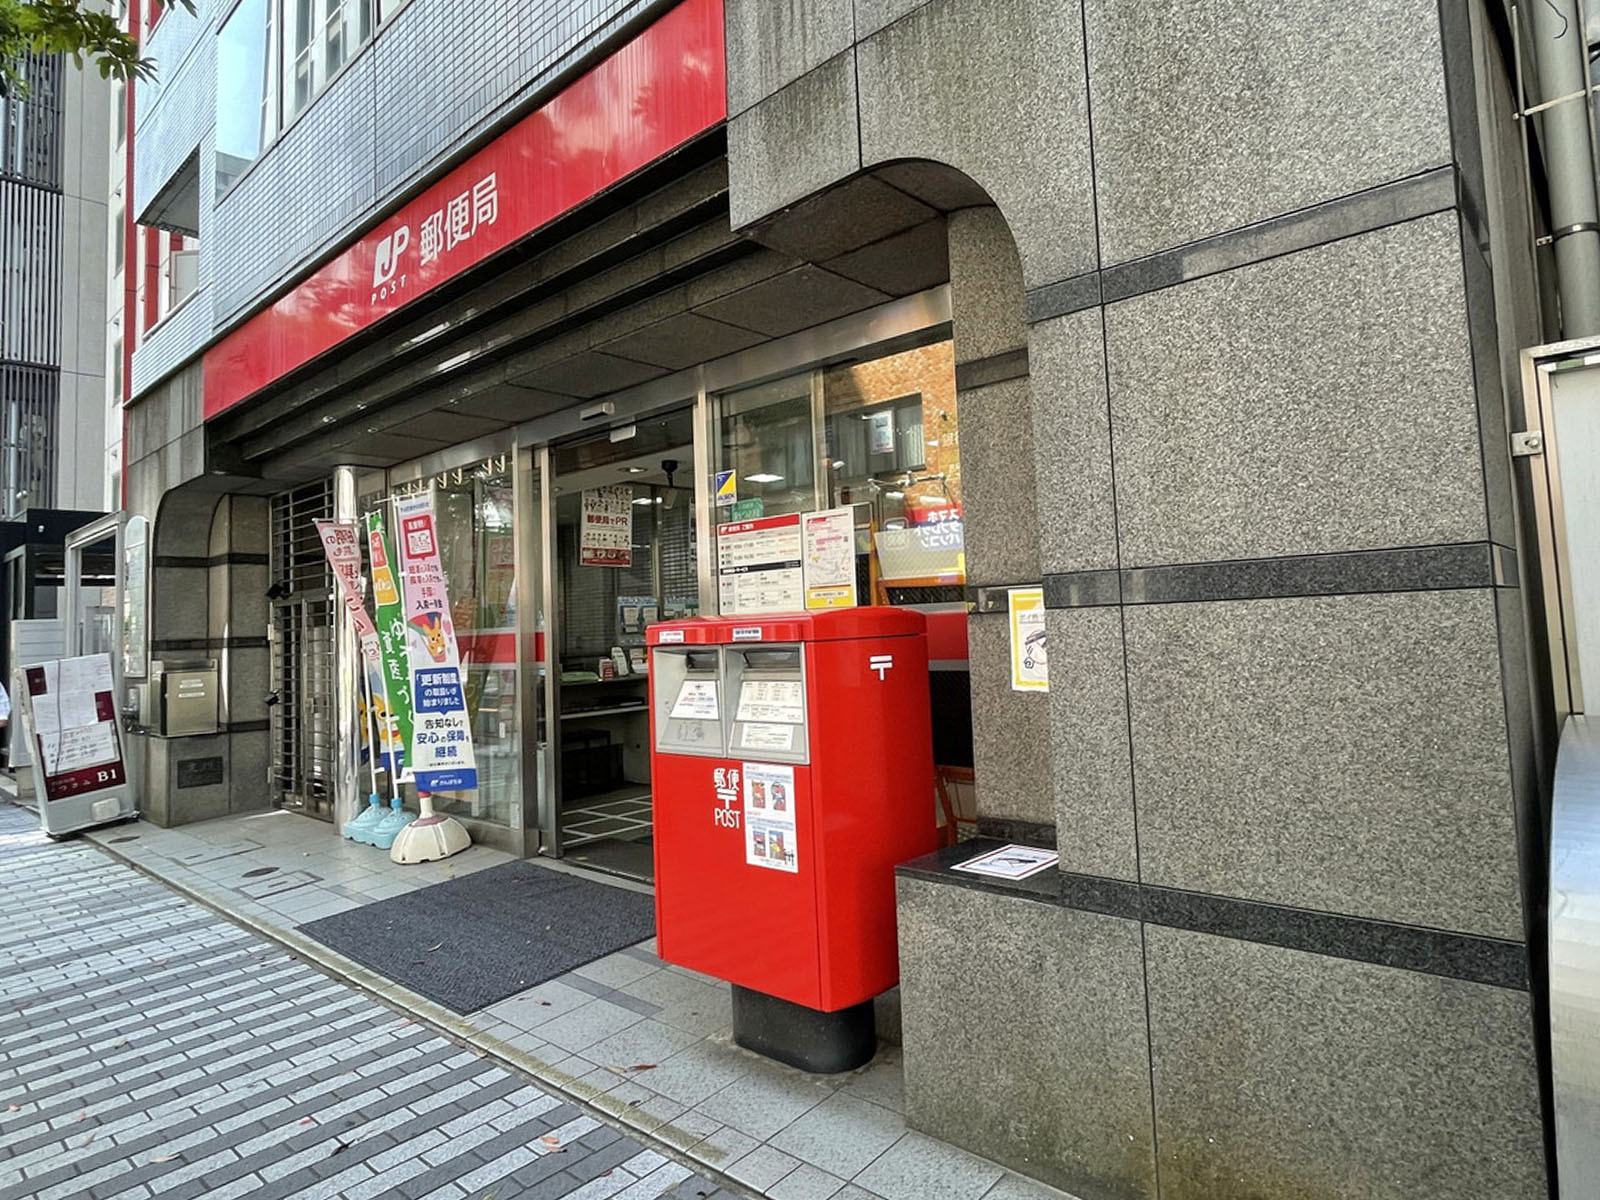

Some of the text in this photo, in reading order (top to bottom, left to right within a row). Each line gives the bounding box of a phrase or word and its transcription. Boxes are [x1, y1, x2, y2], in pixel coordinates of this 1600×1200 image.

[420, 171, 498, 267] 郵便局
[371, 274, 407, 305] POST
[422, 696, 460, 707] 始まりました
[96, 768, 117, 783] B1
[714, 807, 741, 829] POST
